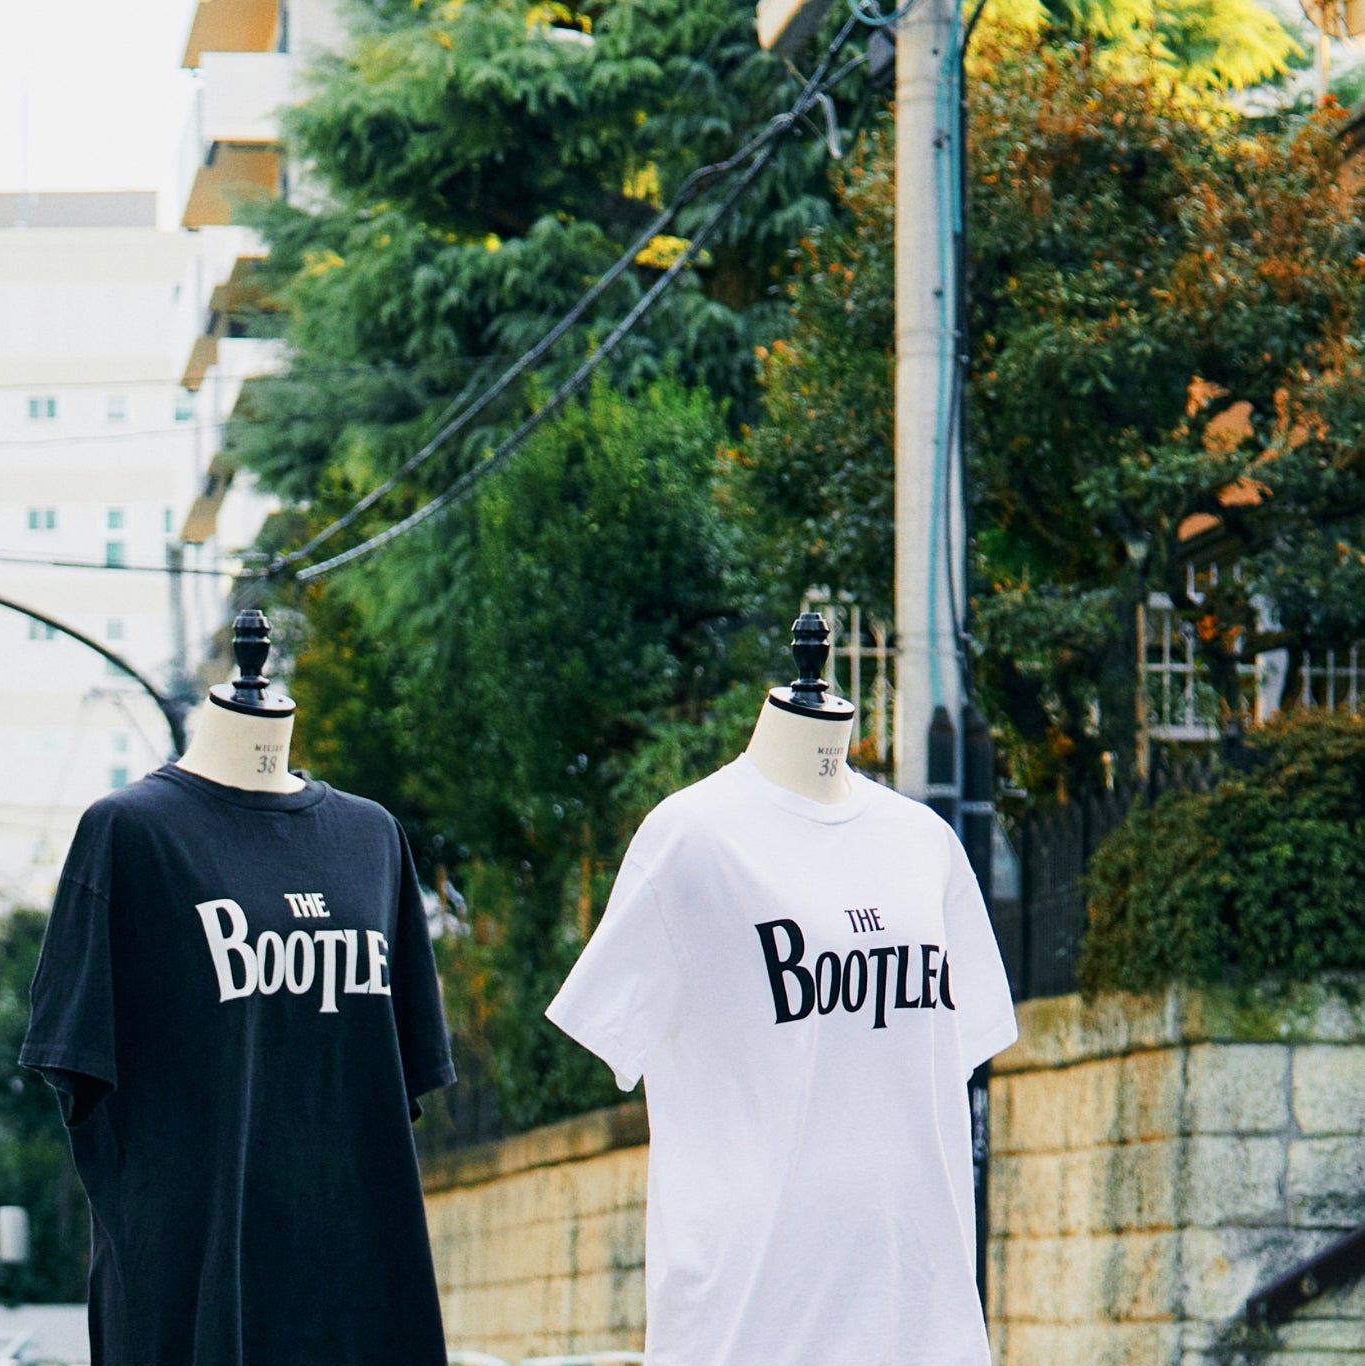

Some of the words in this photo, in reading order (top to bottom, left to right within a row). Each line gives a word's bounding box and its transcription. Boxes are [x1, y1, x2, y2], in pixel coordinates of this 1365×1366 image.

[257, 755, 277, 774] 38
[818, 758, 838, 777] 38
[284, 893, 331, 918] THE
[844, 907, 885, 933] THE
